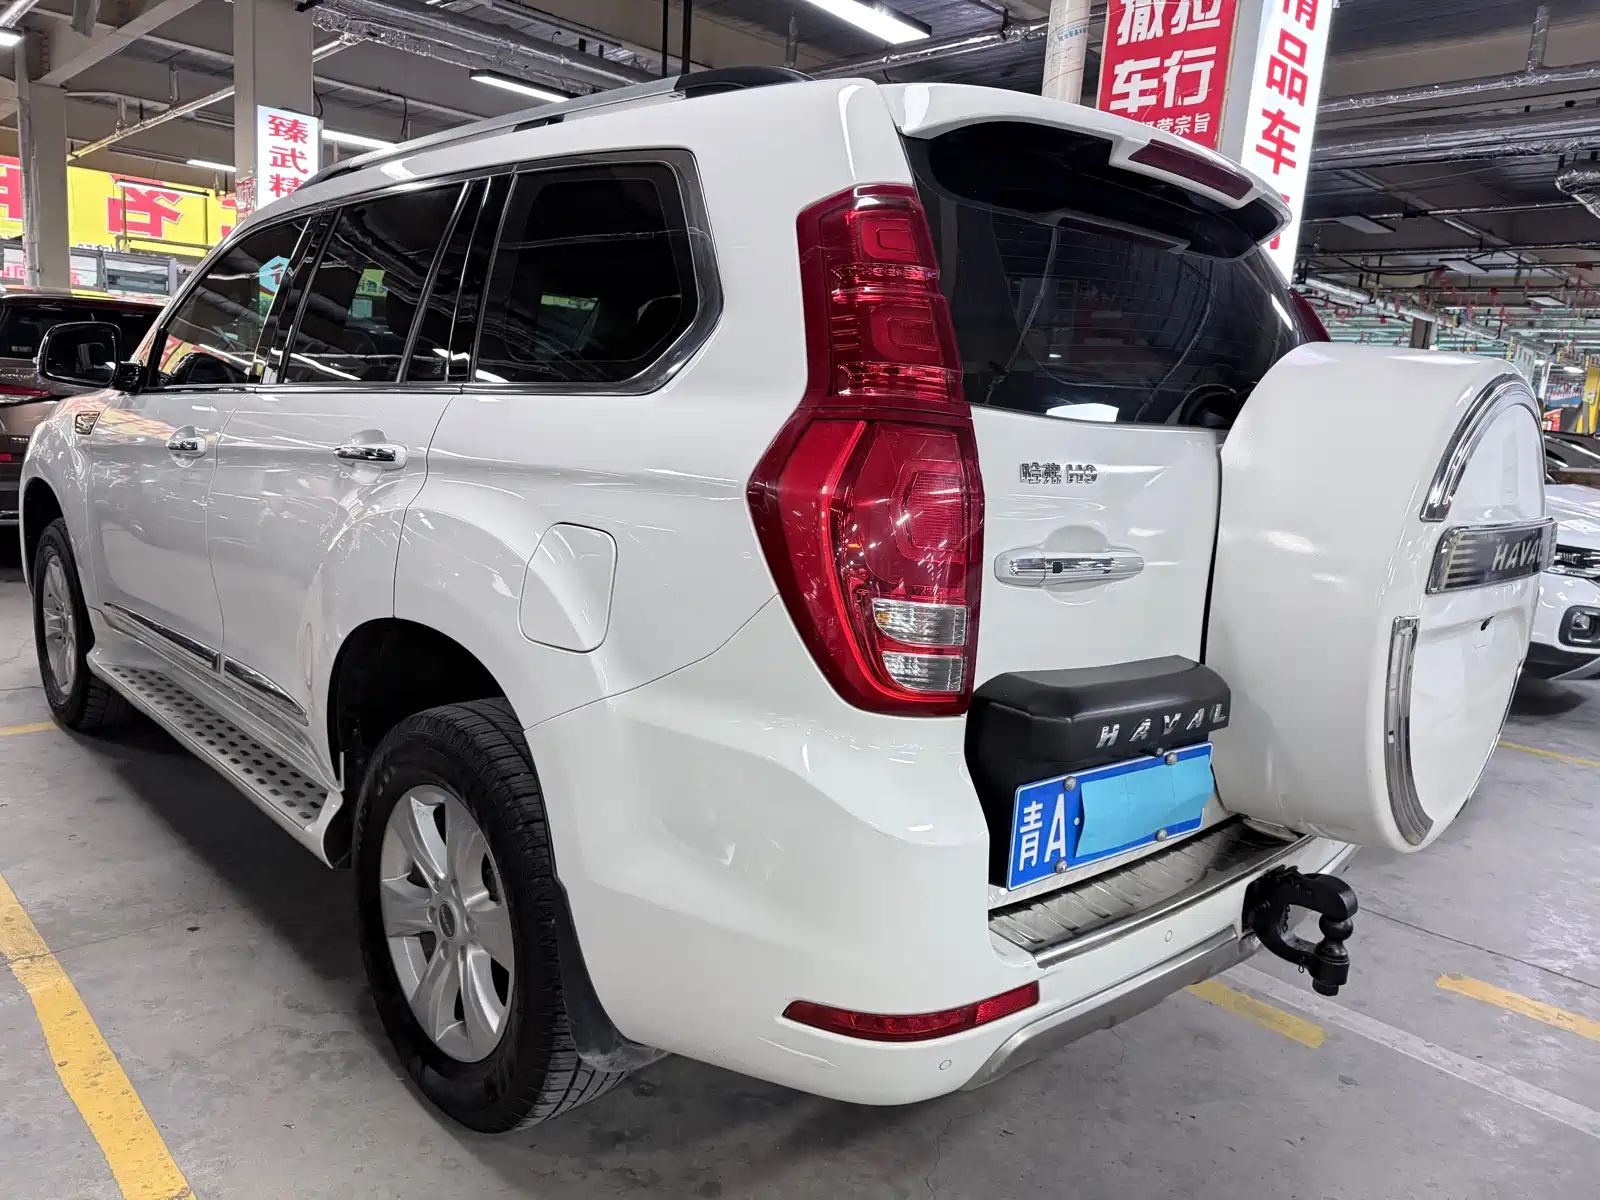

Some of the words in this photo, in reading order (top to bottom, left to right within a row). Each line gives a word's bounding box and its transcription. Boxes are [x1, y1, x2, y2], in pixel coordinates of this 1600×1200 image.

[1109, 46, 1217, 113] 车行
[1255, 0, 1317, 250] 品车
[1066, 464, 1098, 484] H9
[1491, 537, 1544, 572] HAVAL
[1096, 703, 1227, 749] HAVAL
